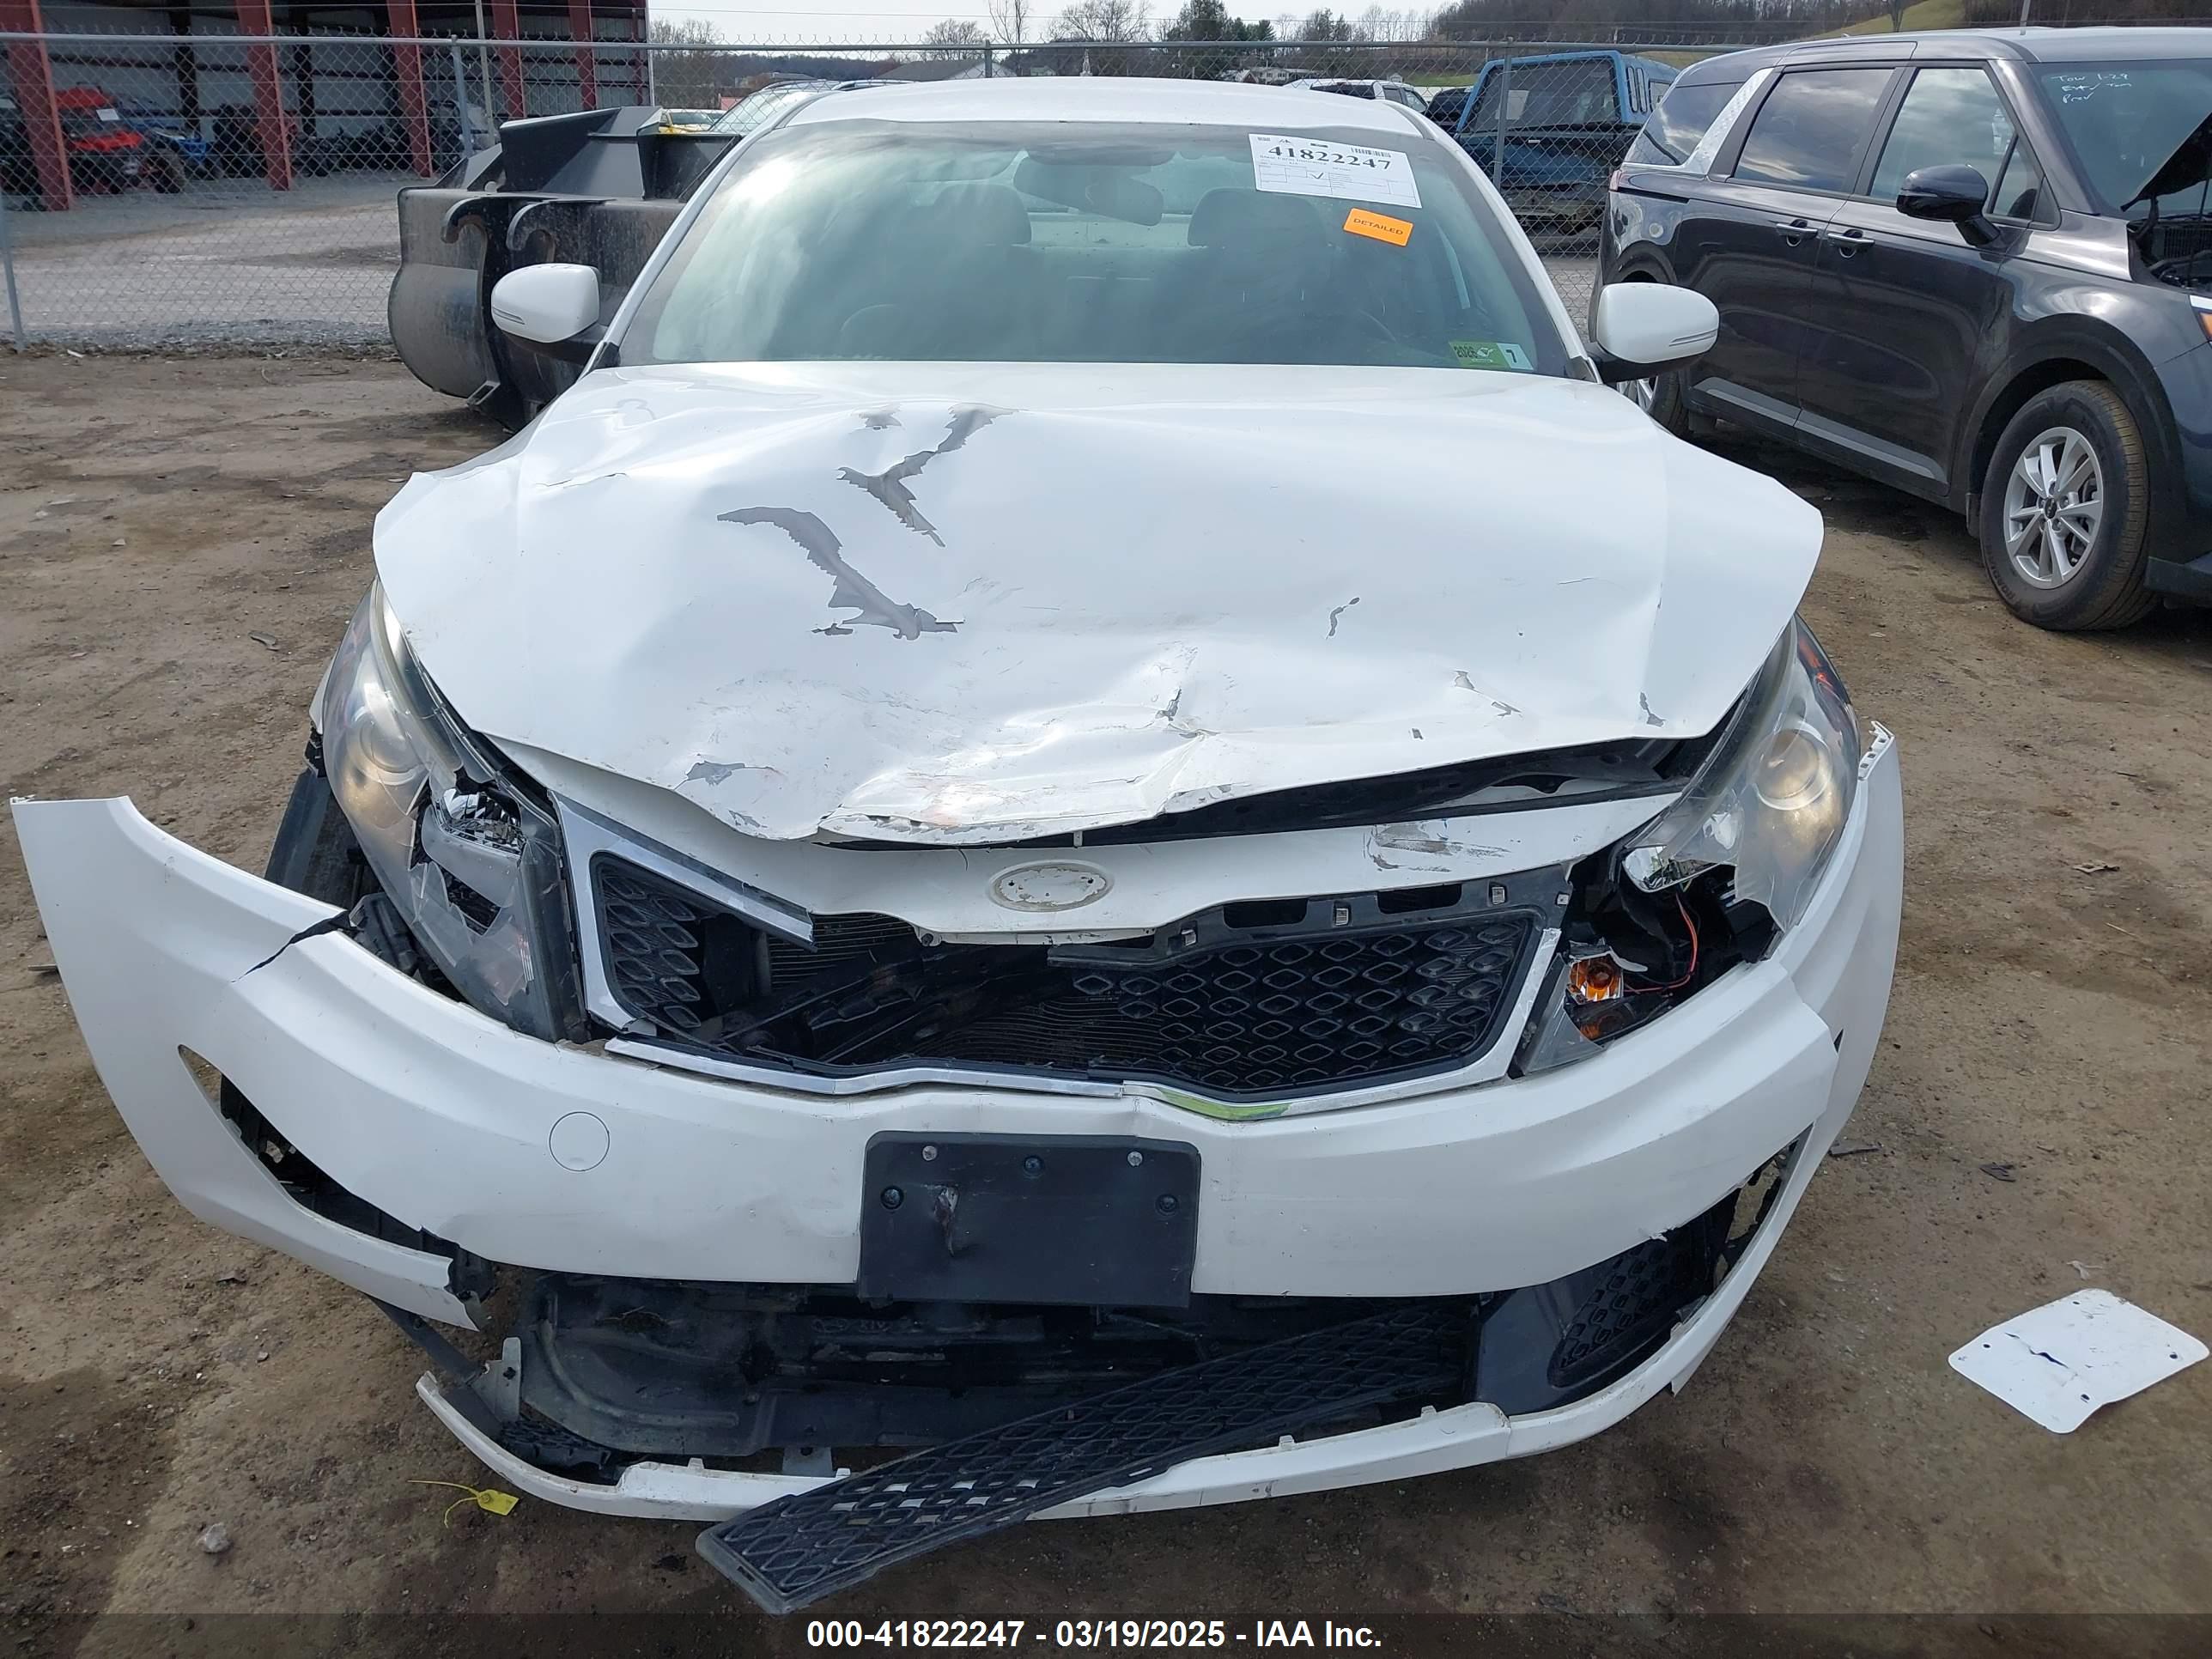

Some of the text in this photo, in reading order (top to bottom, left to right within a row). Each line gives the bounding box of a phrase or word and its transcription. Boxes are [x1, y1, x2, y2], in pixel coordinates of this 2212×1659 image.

[1268, 146, 1390, 170] 41822247
[1353, 218, 1403, 235] DETAILED
[1505, 349, 1517, 363] 7
